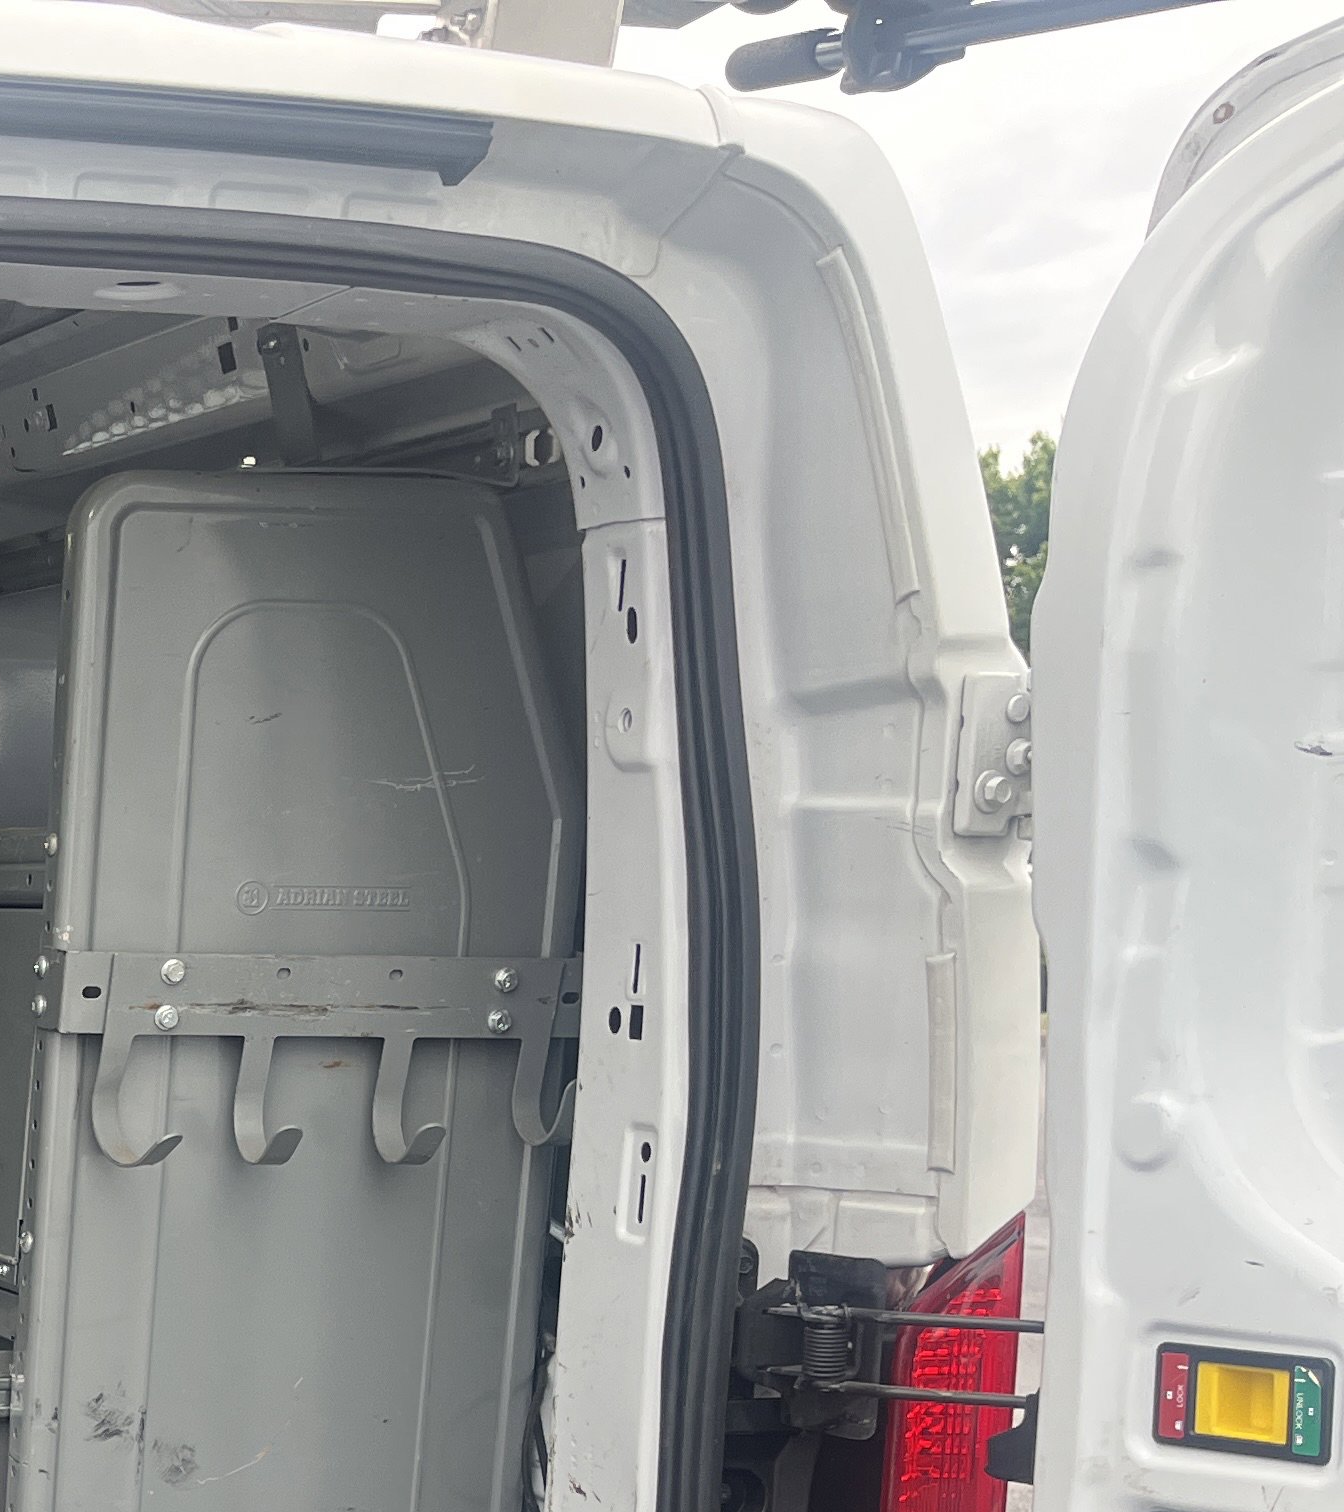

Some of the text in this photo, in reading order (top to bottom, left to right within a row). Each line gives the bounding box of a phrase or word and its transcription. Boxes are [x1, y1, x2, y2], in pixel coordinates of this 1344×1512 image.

[275, 887, 409, 907] ADRIAN STEEL
[1176, 1384, 1184, 1408] LOCK
[1295, 1392, 1304, 1430] UNLOCK
